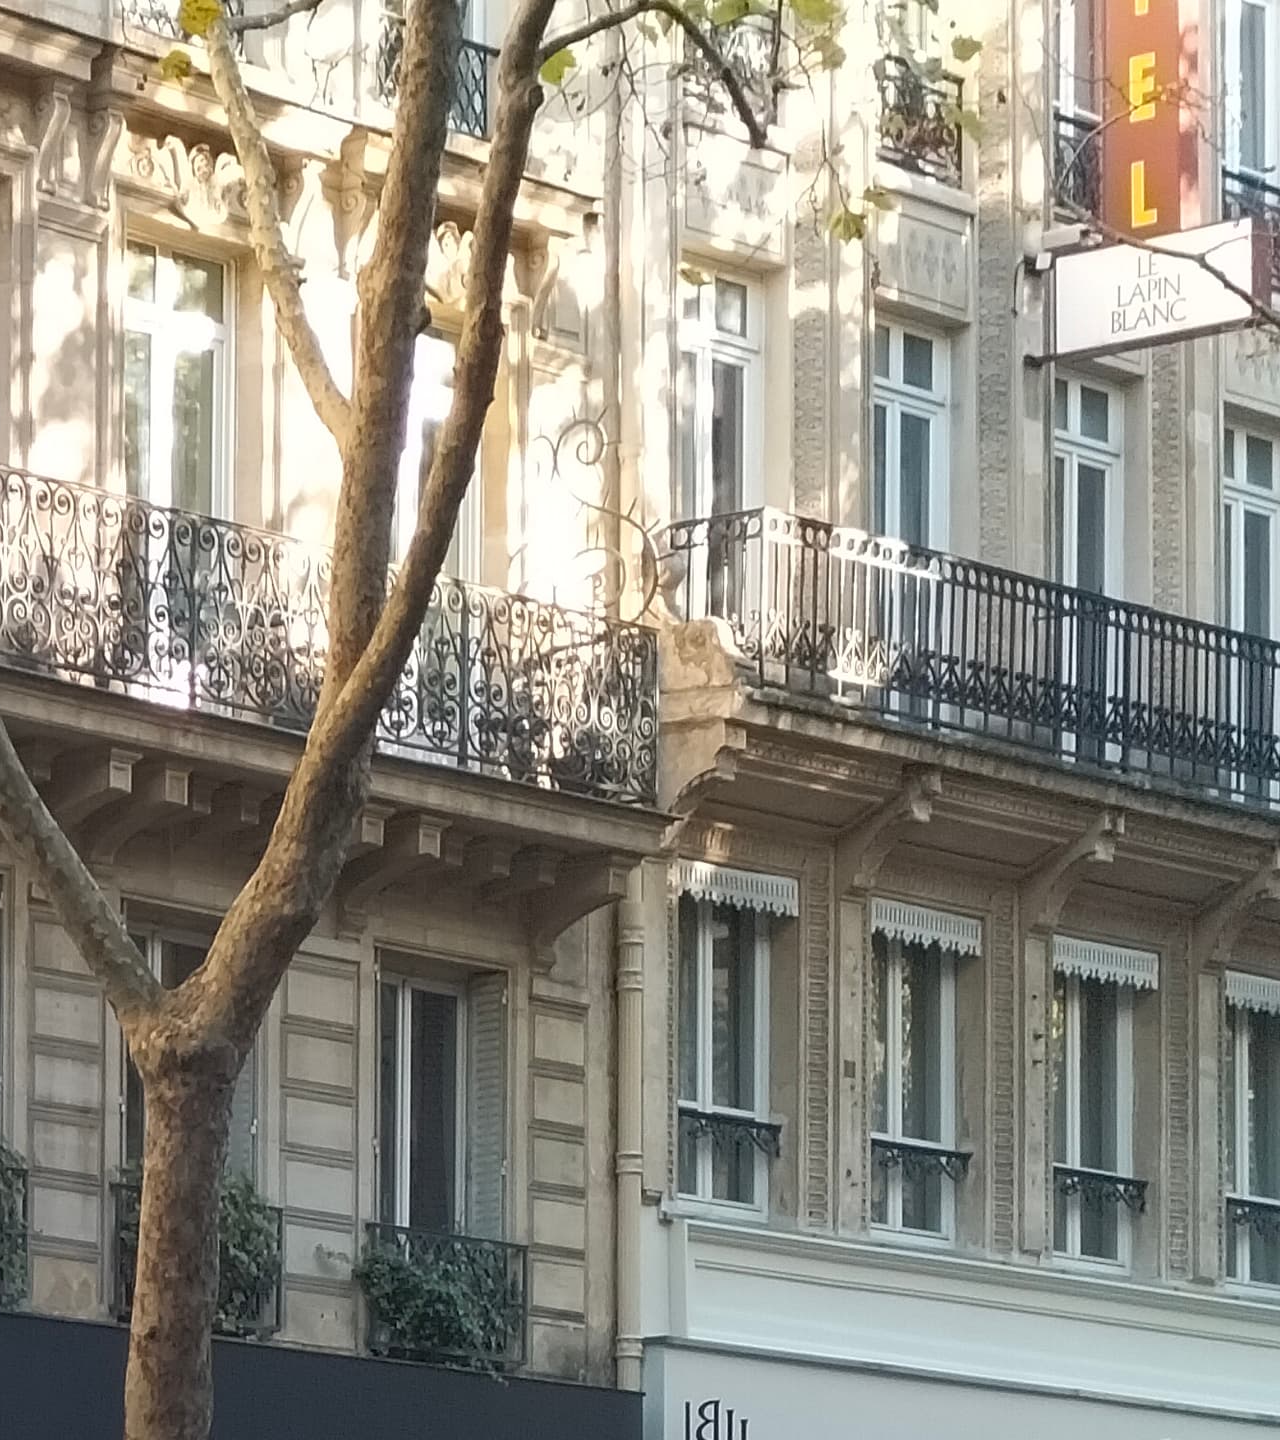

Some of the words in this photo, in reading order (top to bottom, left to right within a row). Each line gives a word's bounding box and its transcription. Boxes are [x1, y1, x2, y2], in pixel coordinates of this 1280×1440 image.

[1128, 0, 1158, 229] EL
[1138, 252, 1160, 279] LE
[1117, 273, 1181, 308] LAPIN
[1111, 297, 1187, 334] BLANC
